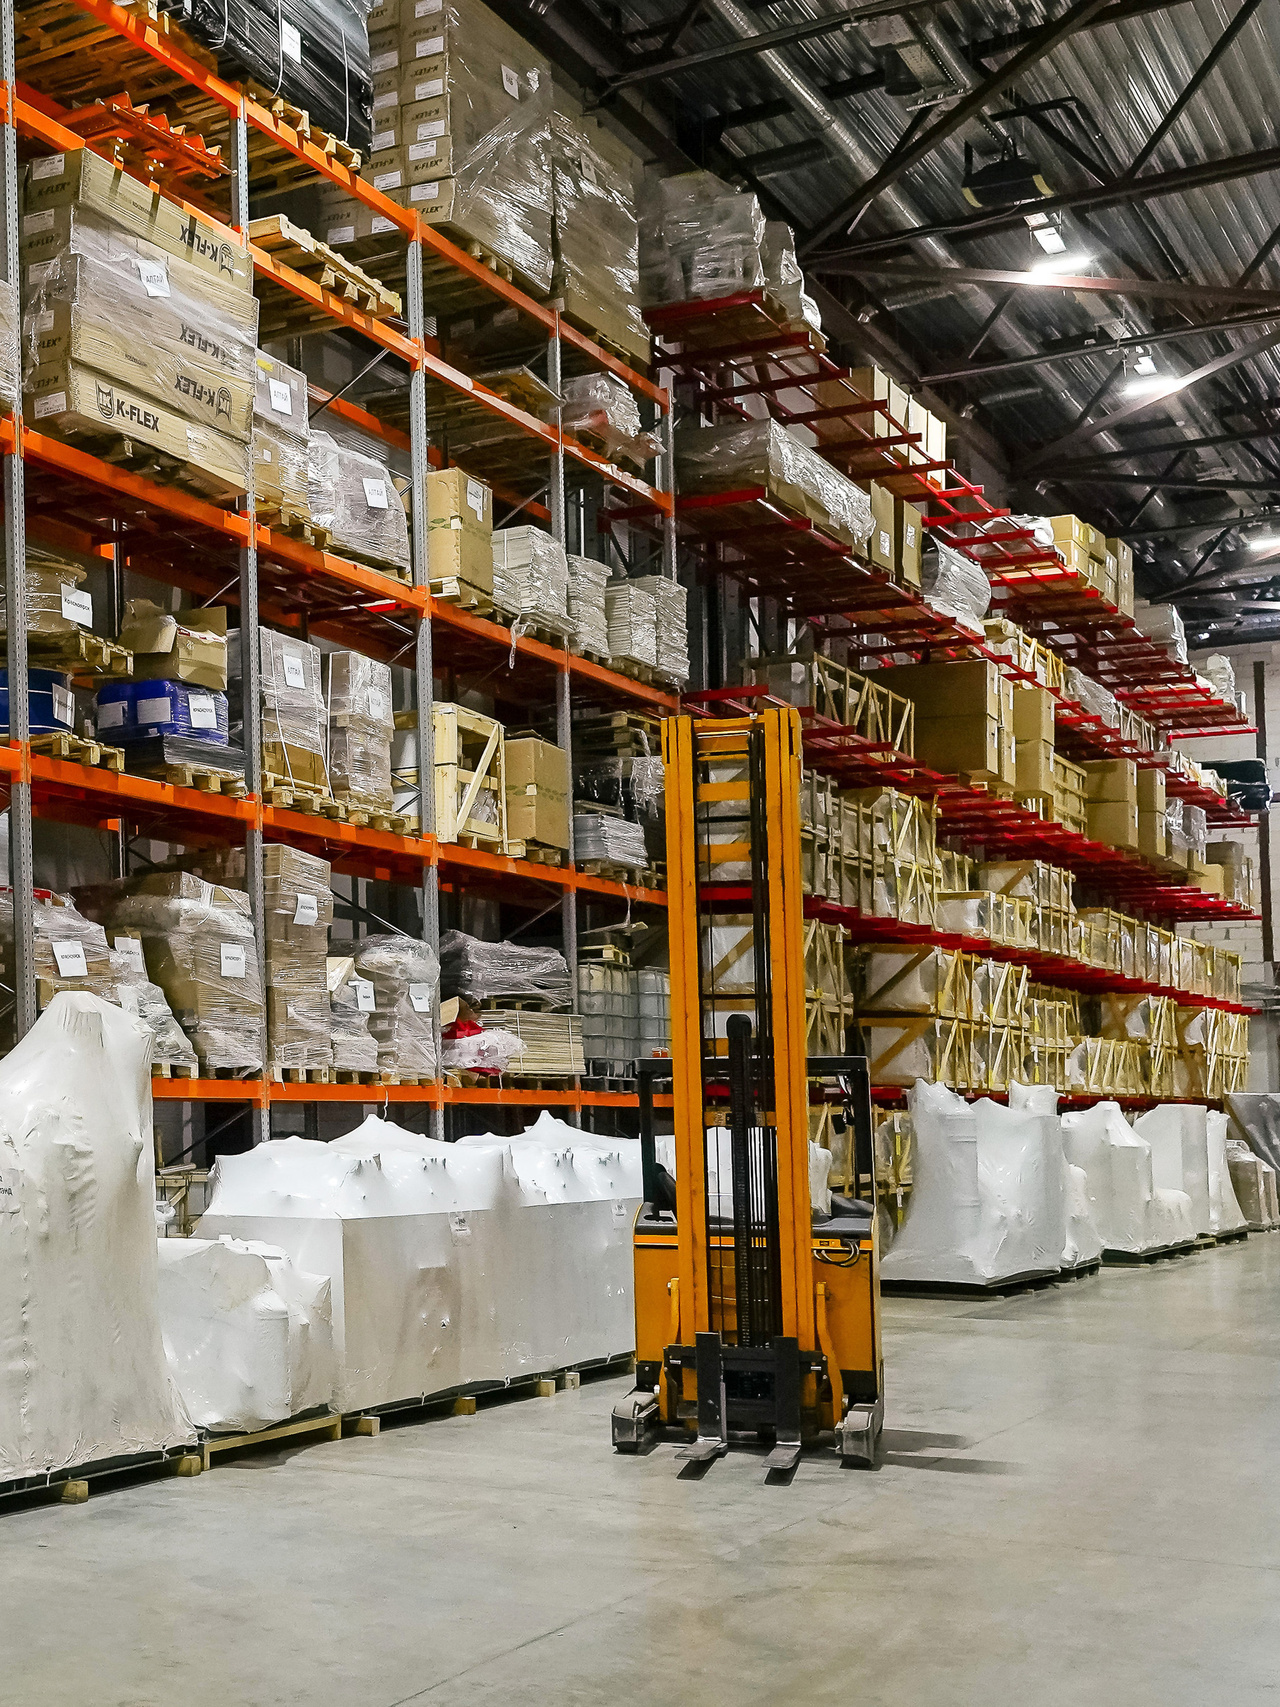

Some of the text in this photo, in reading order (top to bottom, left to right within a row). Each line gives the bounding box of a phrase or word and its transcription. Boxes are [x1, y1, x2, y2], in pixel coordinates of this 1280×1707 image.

[179, 224, 218, 262] K-FLEX
[174, 374, 216, 407] K-FLEX
[116, 398, 160, 433] K-FLEX
